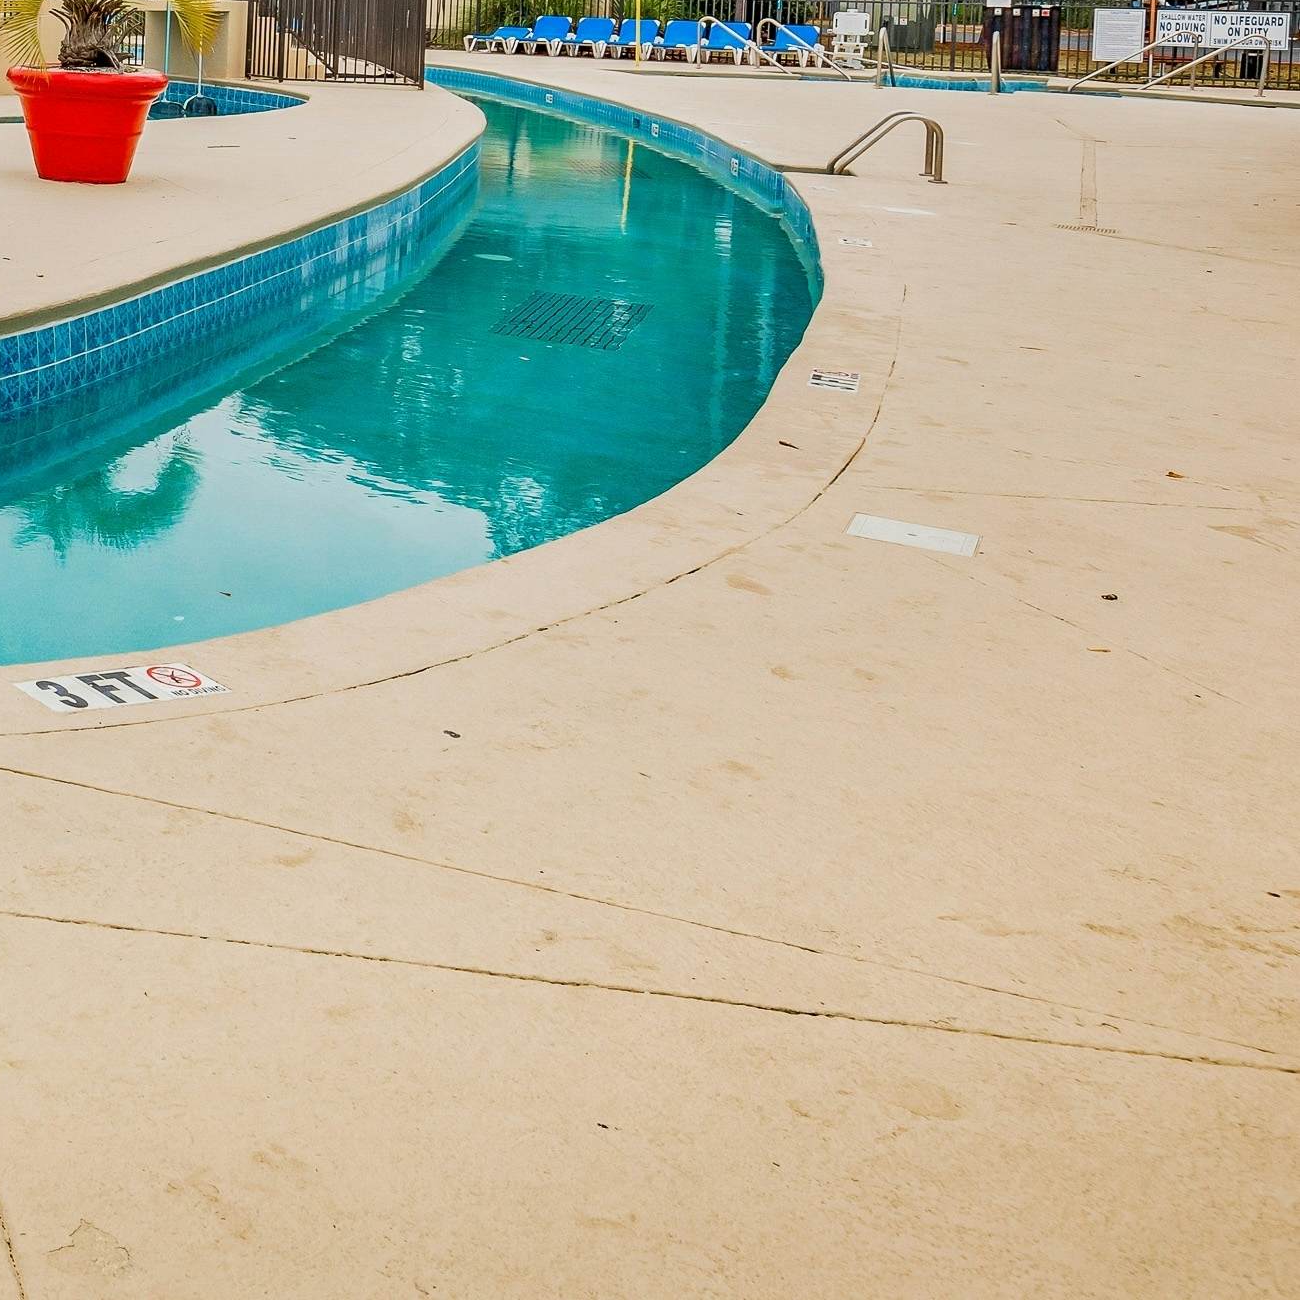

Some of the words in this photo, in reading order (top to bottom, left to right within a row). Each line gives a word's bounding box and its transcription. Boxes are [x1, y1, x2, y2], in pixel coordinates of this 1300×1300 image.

[1161, 13, 1186, 21] SHALLOW
[1214, 16, 1228, 25] NO
[1230, 16, 1284, 26] LIFEGUARD
[1160, 22, 1172, 31] NO
[1175, 22, 1206, 33] DIVING
[1227, 27, 1241, 36] ON
[35, 680, 89, 709] 3
[76, 671, 160, 704] FT
[188, 685, 226, 695] DIVING
